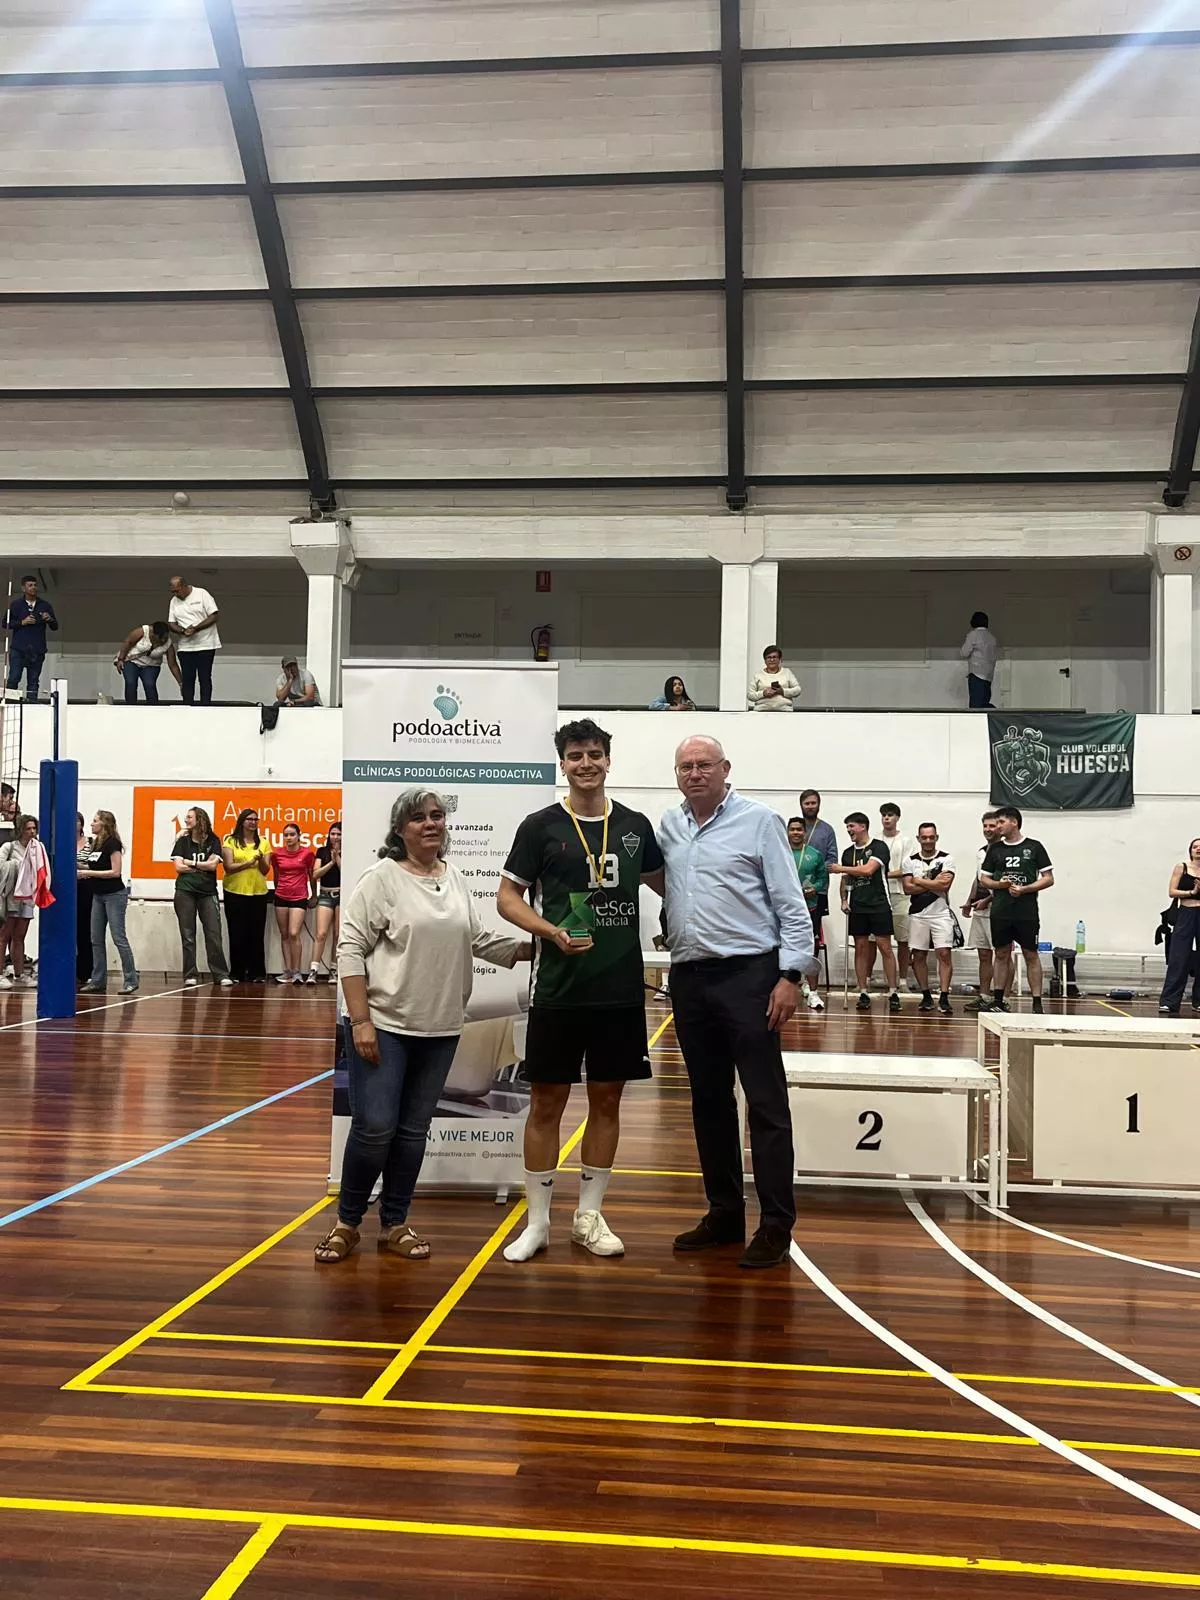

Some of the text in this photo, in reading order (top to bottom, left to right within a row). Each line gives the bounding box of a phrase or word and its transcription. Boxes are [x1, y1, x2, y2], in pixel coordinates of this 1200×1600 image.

[393, 719, 502, 743] podoactiva
[455, 737, 502, 745] BIOMECÁNICA
[1061, 743, 1127, 753] CLUB VOLEIBOL
[1056, 754, 1130, 774] HUESCA
[354, 765, 543, 779] CLÍNICAS PODOLÓGICAS PODOACTIVA
[455, 823, 494, 832] avanzada
[446, 849, 488, 857] omecánico
[1005, 856, 1020, 868] 22
[476, 869, 500, 877] Podoa
[585, 853, 620, 889] 13
[470, 889, 498, 899] ógicos
[595, 900, 635, 916] esca
[473, 966, 497, 975] lógica
[1126, 1092, 1141, 1134] 1
[439, 1130, 467, 1141] VIVE
[471, 1131, 514, 1142] MEJOR
[855, 1110, 884, 1151] 2
